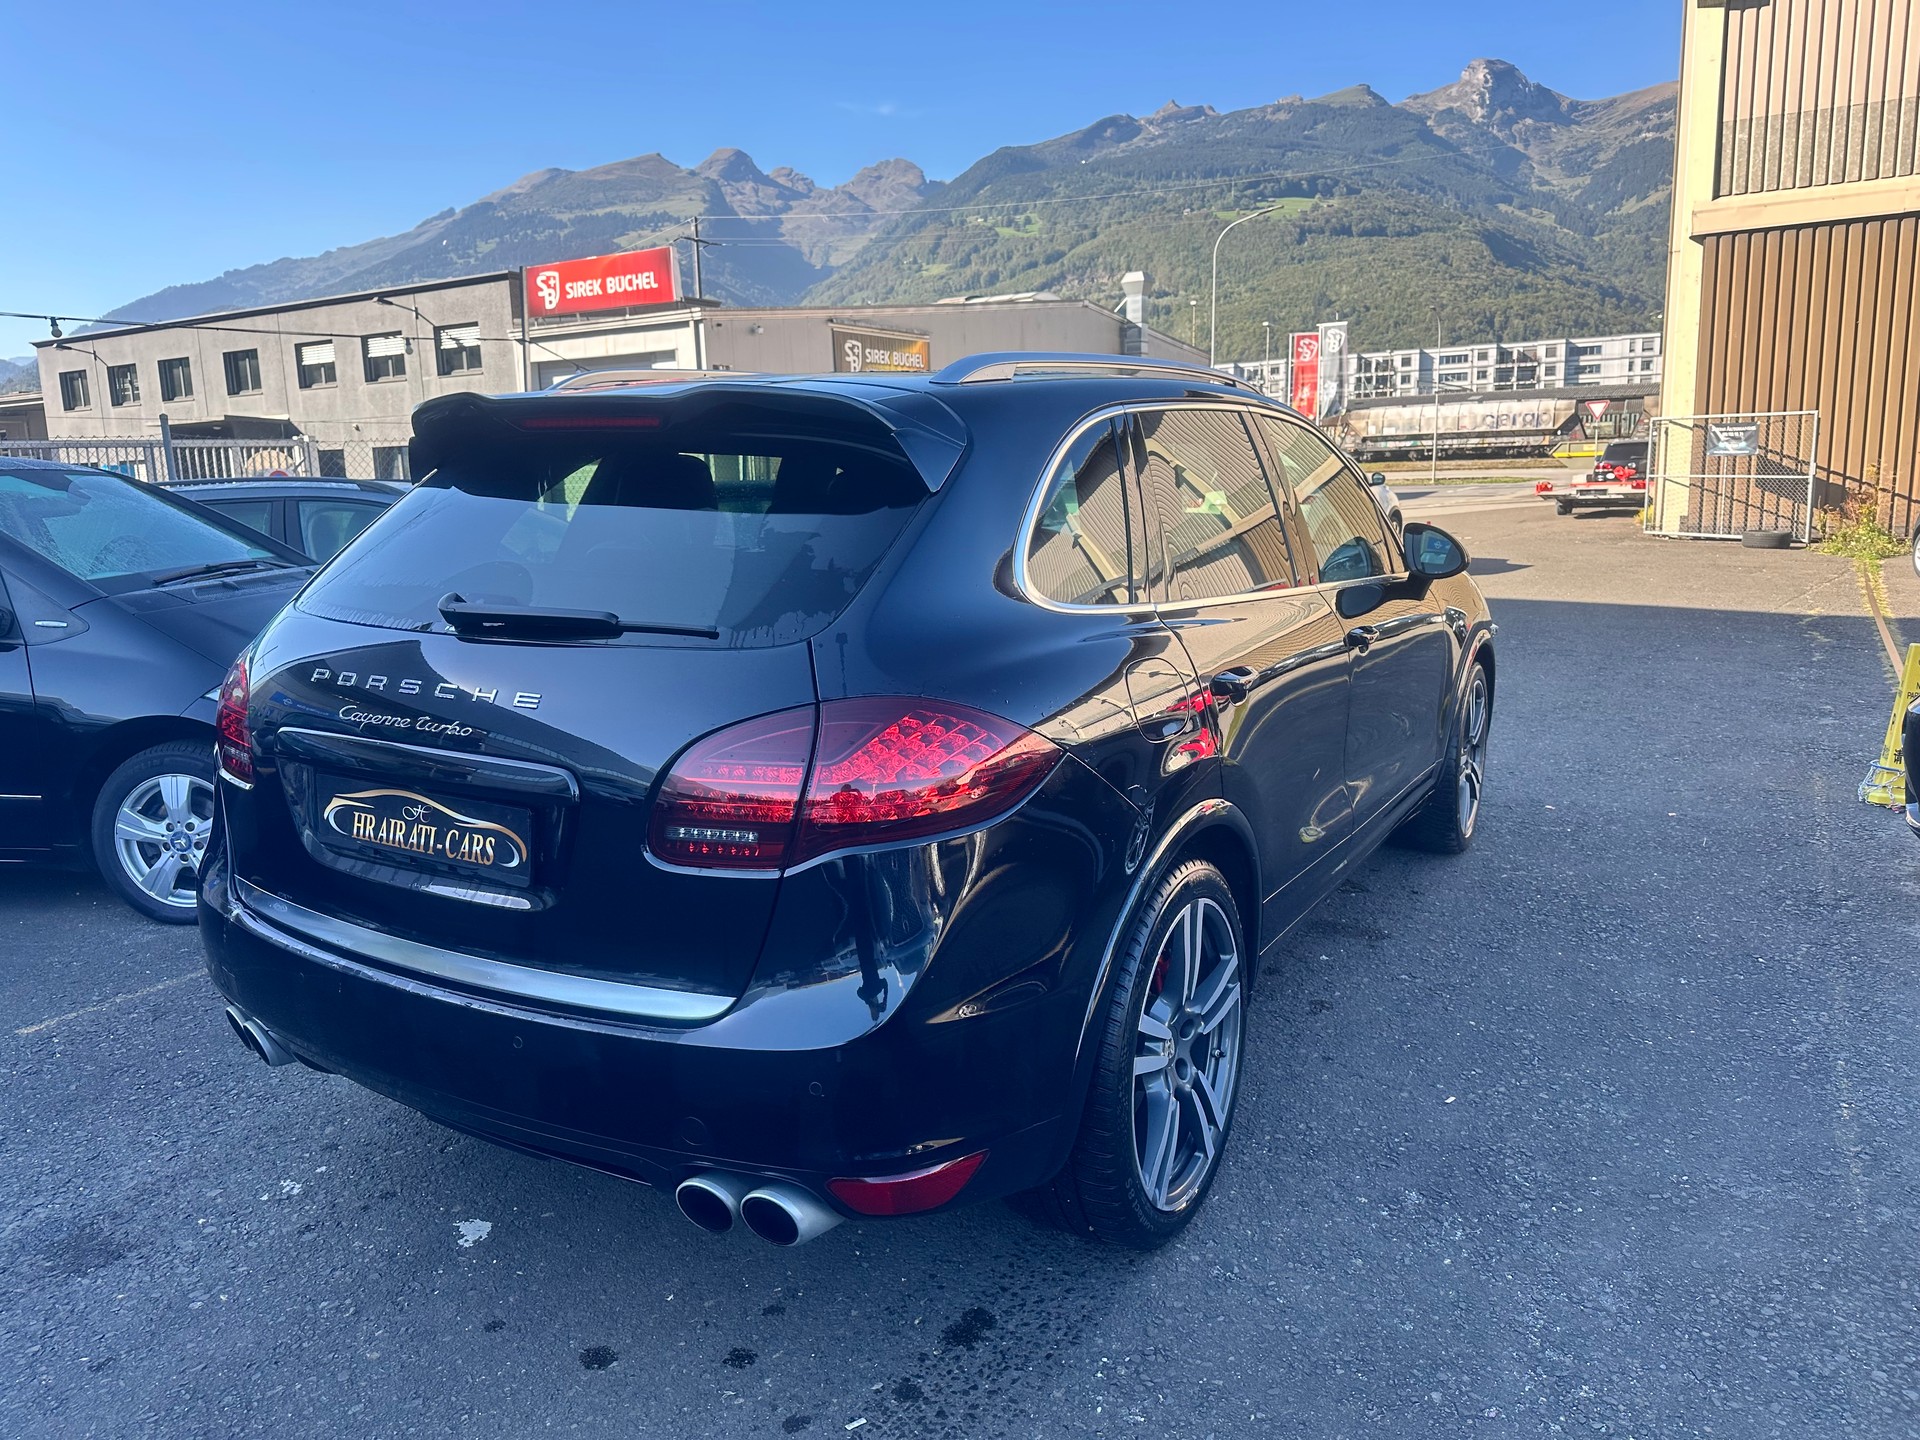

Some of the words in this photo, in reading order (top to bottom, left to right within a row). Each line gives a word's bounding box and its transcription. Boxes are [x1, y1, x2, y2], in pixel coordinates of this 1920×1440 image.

[565, 278, 602, 299] SIREK
[865, 348, 890, 365] SIREK
[310, 667, 543, 710] PORSCHE
[338, 704, 412, 733] Cayenne
